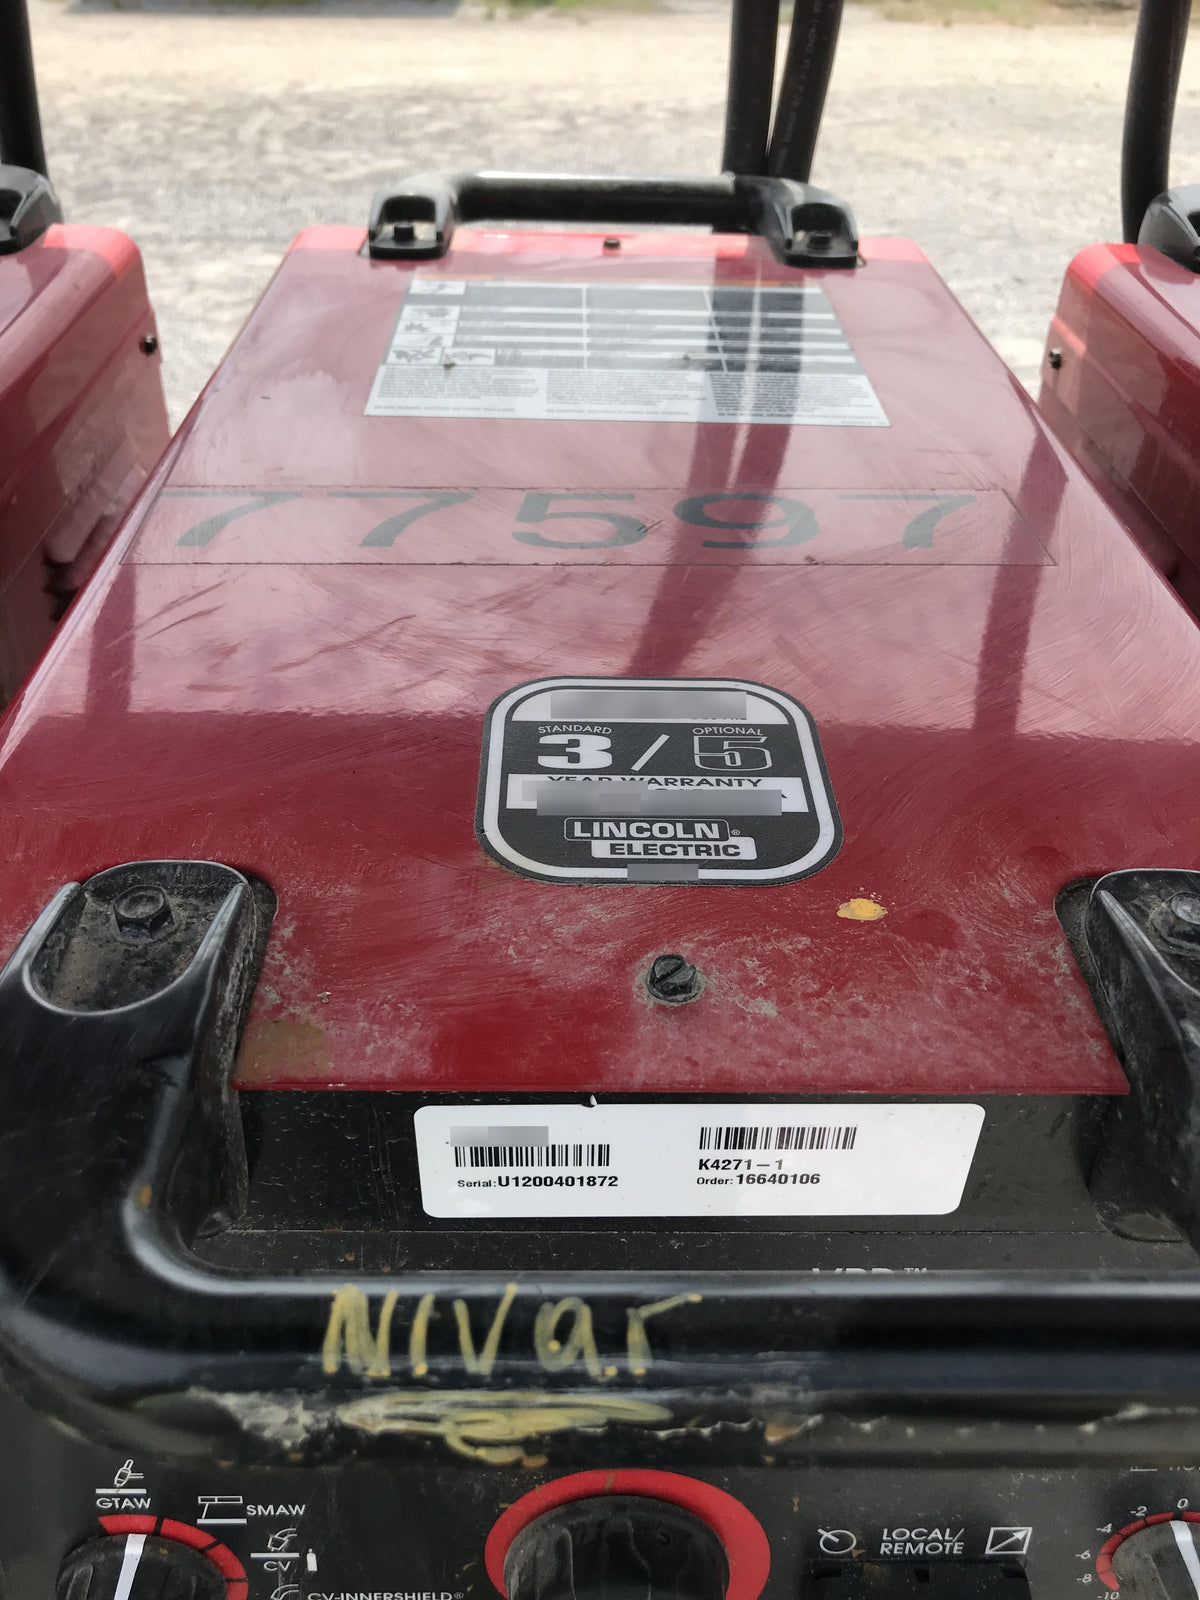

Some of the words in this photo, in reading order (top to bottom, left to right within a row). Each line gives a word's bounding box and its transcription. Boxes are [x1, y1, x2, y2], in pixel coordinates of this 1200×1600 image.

[163, 490, 977, 549] 77597
[538, 724, 612, 735] STANDARD
[692, 726, 764, 737] OPTIONAL
[537, 735, 613, 769] 3
[693, 736, 773, 771] 5
[609, 843, 741, 858] ELECTRIC
[96, 1496, 151, 1509] GTAW
[1177, 1498, 1190, 1511] 0
[246, 1504, 306, 1516] SMAW
[1130, 1506, 1147, 1517] -2
[881, 1527, 964, 1542] LOCAL/
[1096, 1523, 1113, 1534] -4
[879, 1542, 964, 1556] REMOTE
[1075, 1550, 1091, 1560] -6
[263, 1560, 291, 1572] CV
[1076, 1574, 1093, 1584] -8
